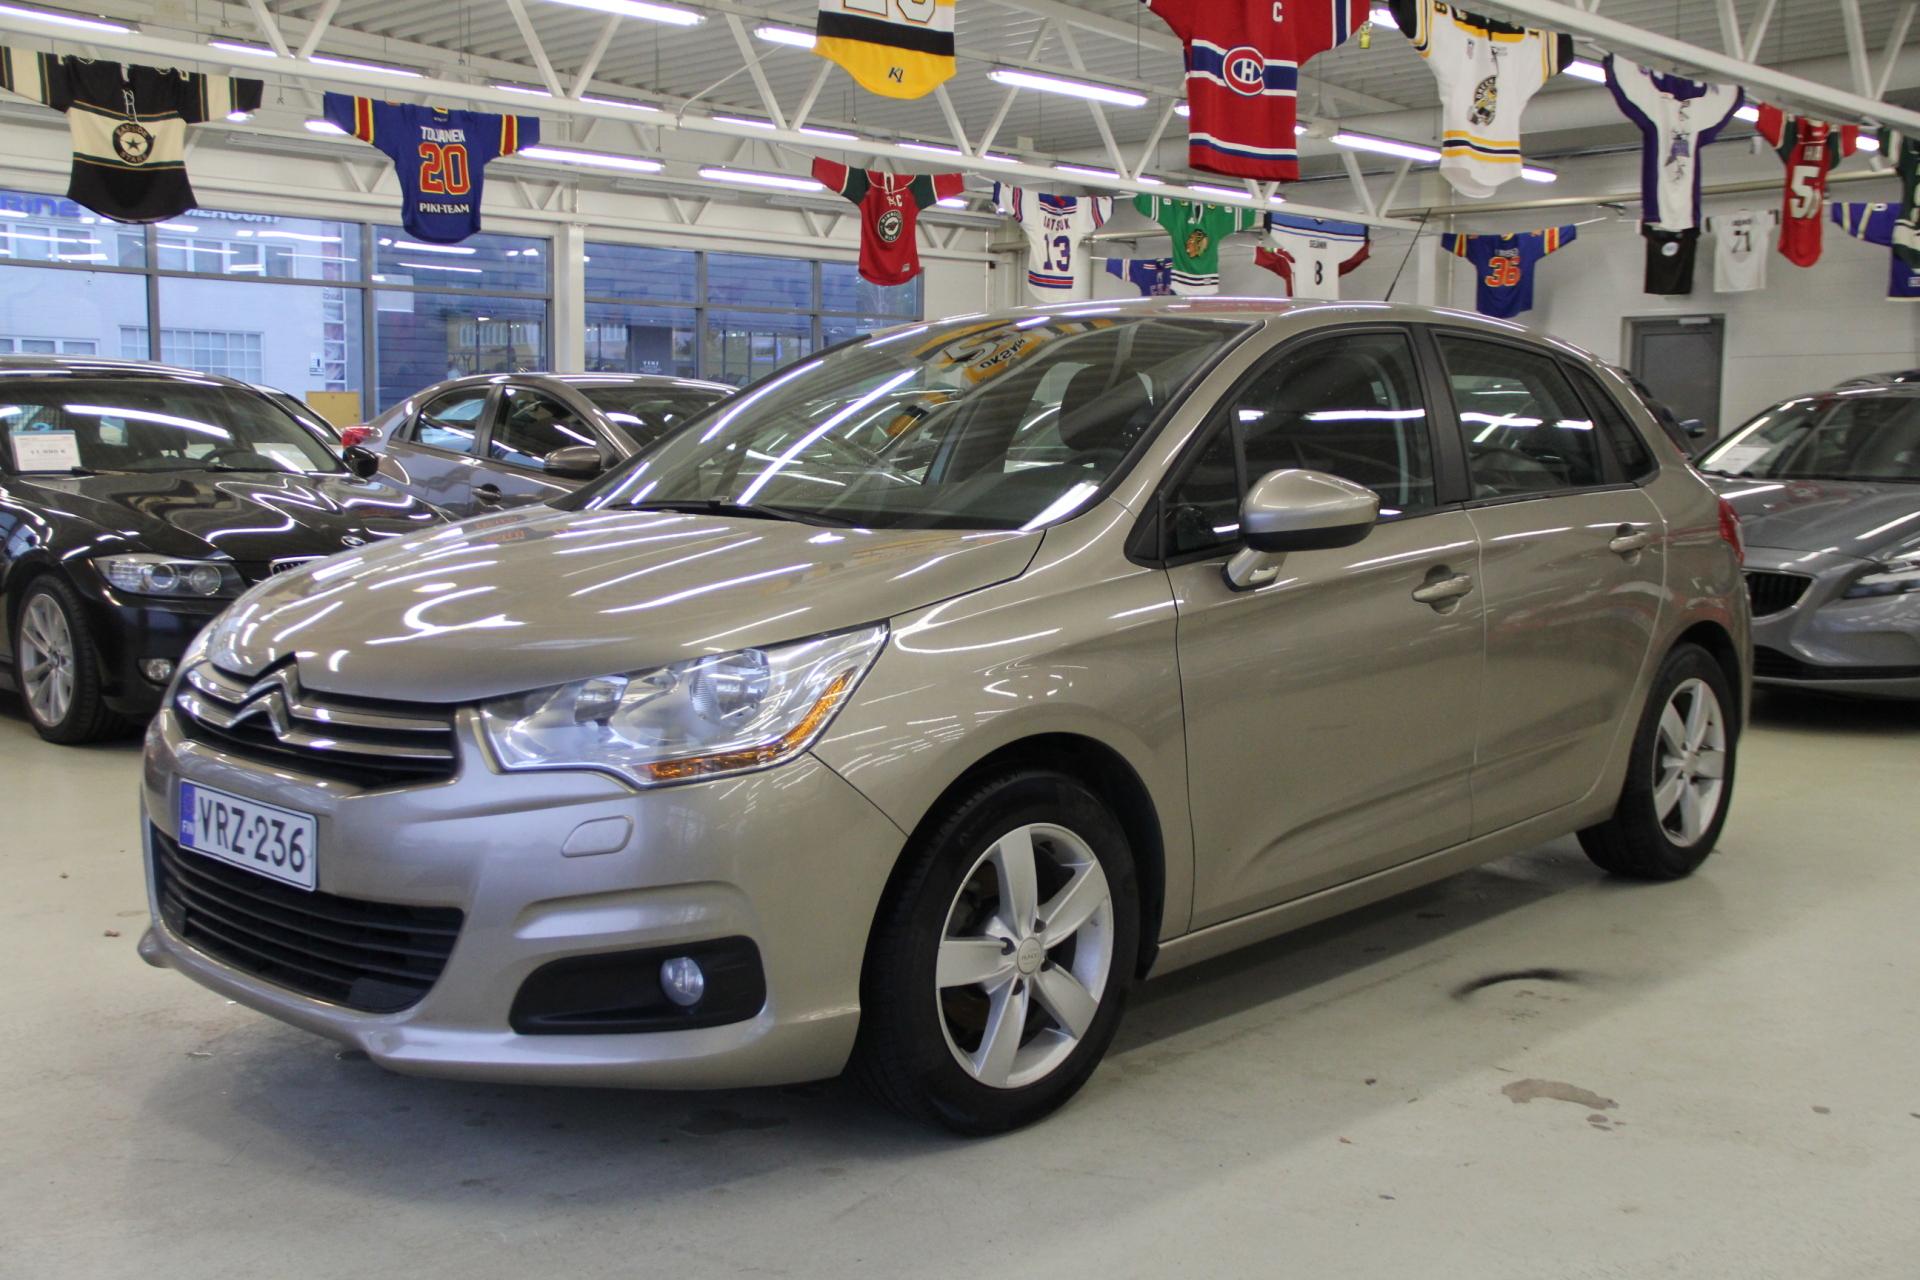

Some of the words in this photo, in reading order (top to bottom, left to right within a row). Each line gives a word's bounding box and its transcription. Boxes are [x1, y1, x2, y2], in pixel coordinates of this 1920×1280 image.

[1272, 1, 1284, 22] C
[418, 142, 470, 195] 20
[419, 203, 470, 214] PIKI-TEAM
[1043, 233, 1071, 272] 13
[1484, 256, 1521, 288] 36
